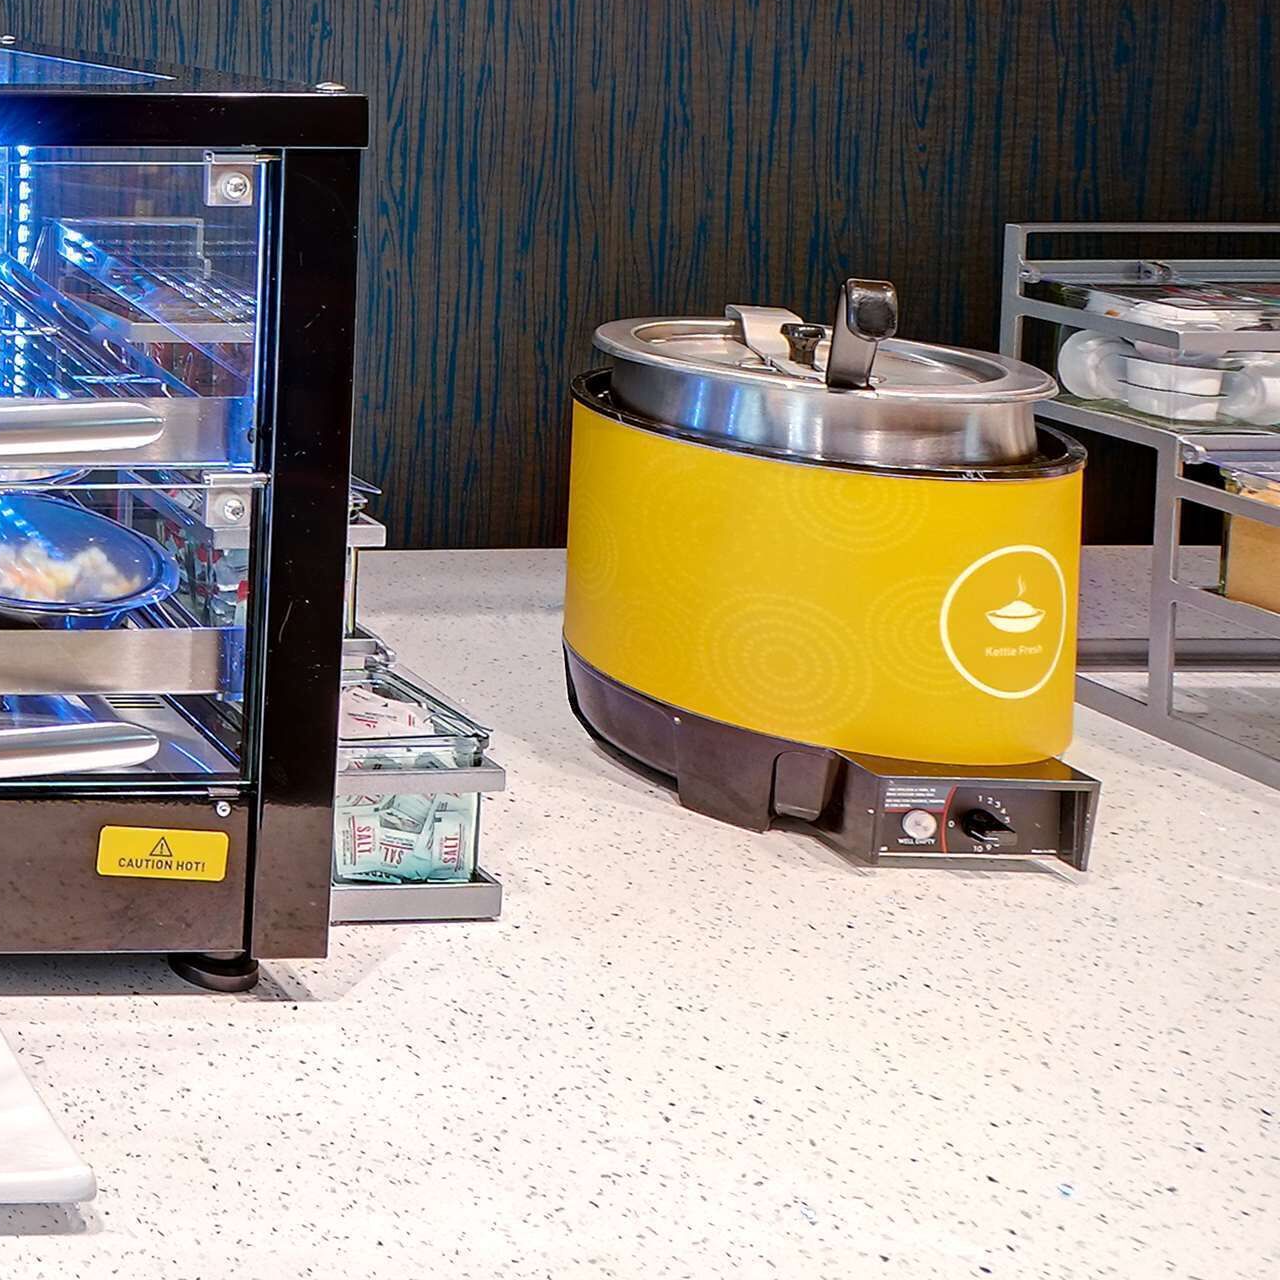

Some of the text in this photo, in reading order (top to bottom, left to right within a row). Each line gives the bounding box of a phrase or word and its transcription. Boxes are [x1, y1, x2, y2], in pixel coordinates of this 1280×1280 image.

[356, 825, 374, 855] SALT
[442, 835, 460, 864] SALT
[118, 857, 205, 873] CAUTION HOT!
[382, 847, 404, 865] SAL
